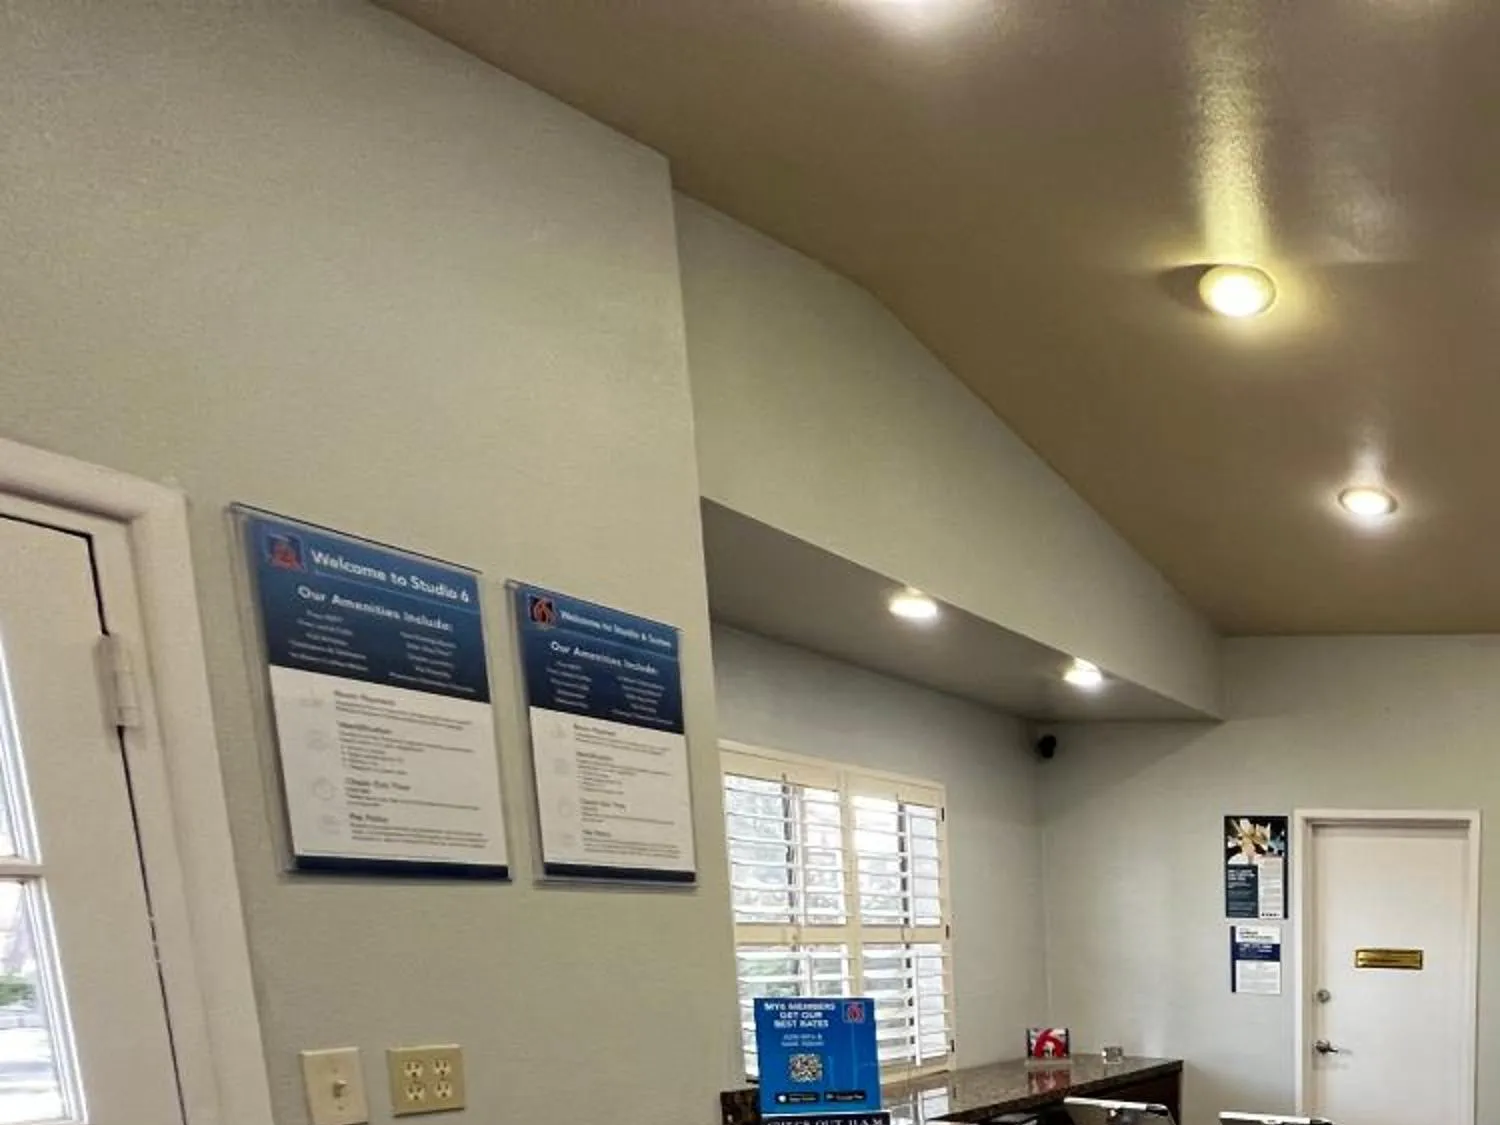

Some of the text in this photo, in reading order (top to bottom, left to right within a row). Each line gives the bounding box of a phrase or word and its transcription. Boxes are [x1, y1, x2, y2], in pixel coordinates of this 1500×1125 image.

[311, 549, 469, 603] Welcome to Studio 6
[297, 584, 326, 602] Our
[331, 593, 401, 618] Amenities
[551, 641, 570, 653] Our
[780, 1011, 823, 1019] GET OUR
[773, 1019, 829, 1028] BEST RATES
